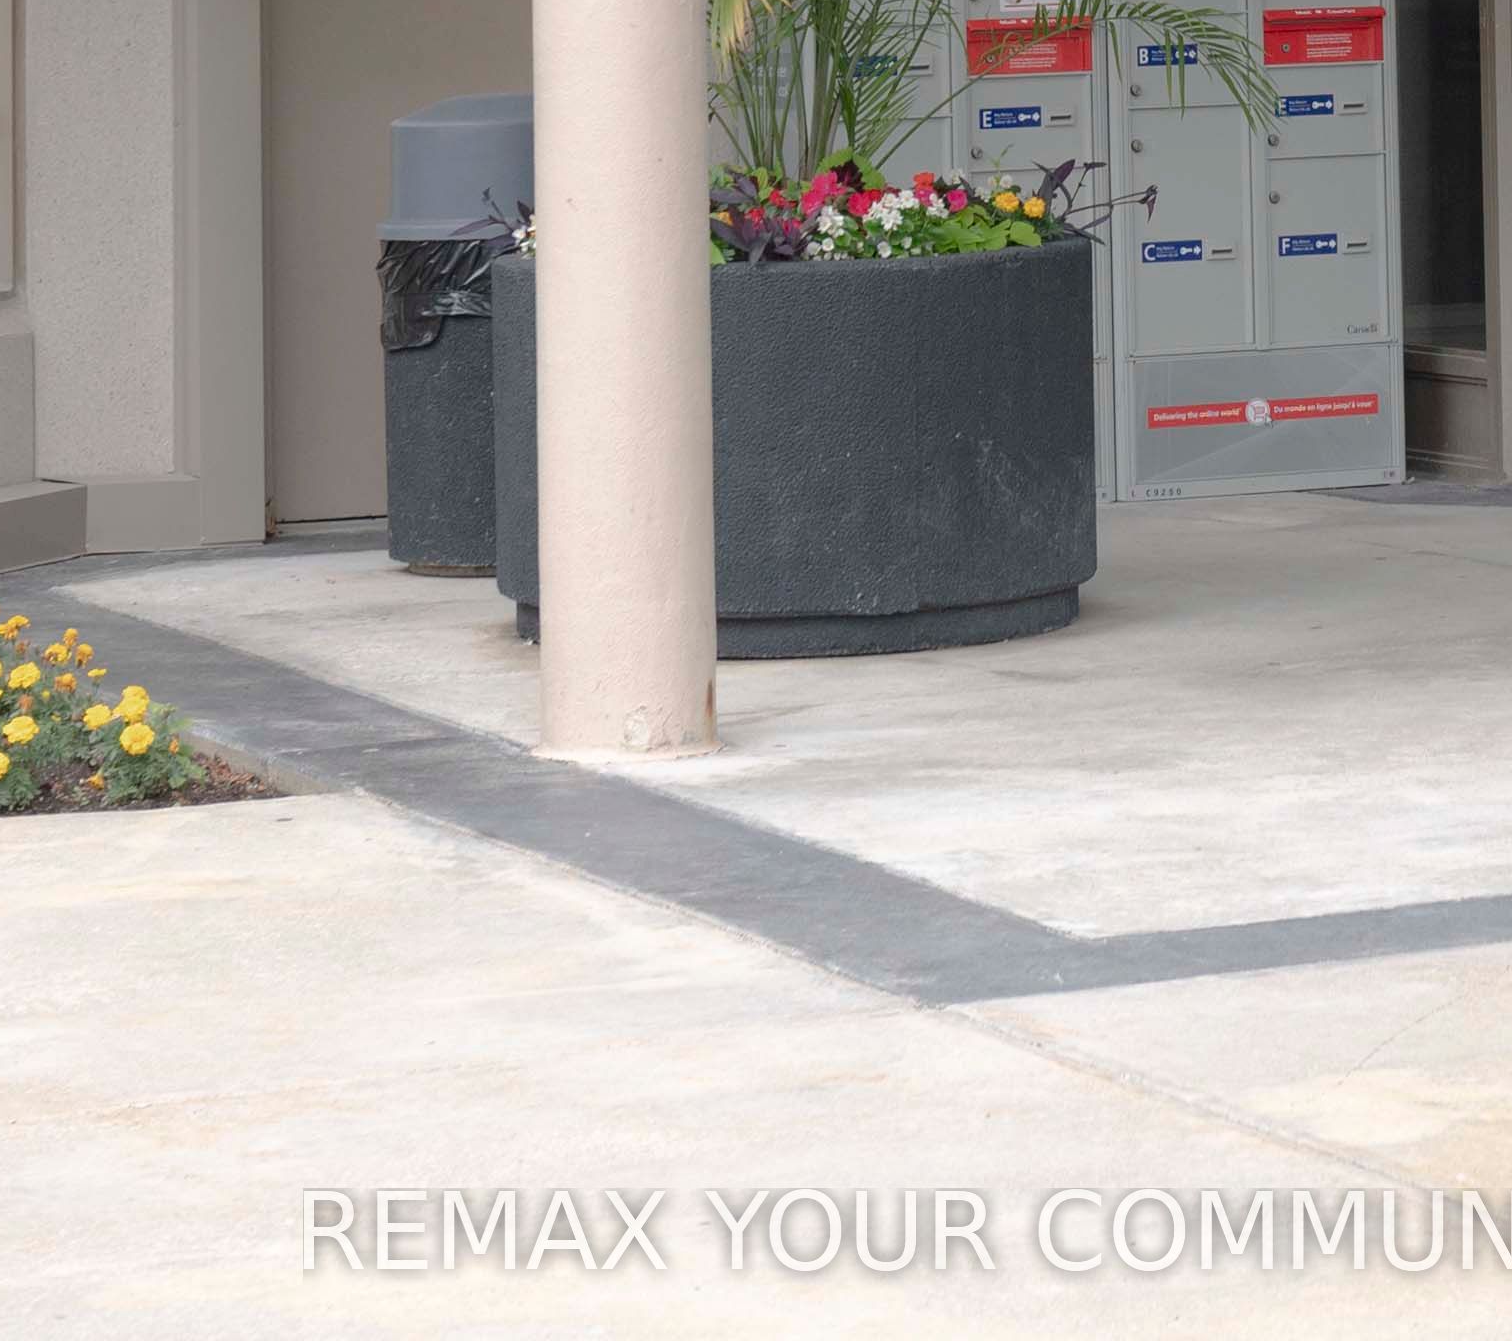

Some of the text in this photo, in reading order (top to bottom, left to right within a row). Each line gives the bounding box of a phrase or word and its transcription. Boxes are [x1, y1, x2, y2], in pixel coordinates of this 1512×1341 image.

[1139, 48, 1149, 65] B
[982, 110, 993, 128] E
[1143, 244, 1156, 261] C
[1281, 238, 1291, 255] F
